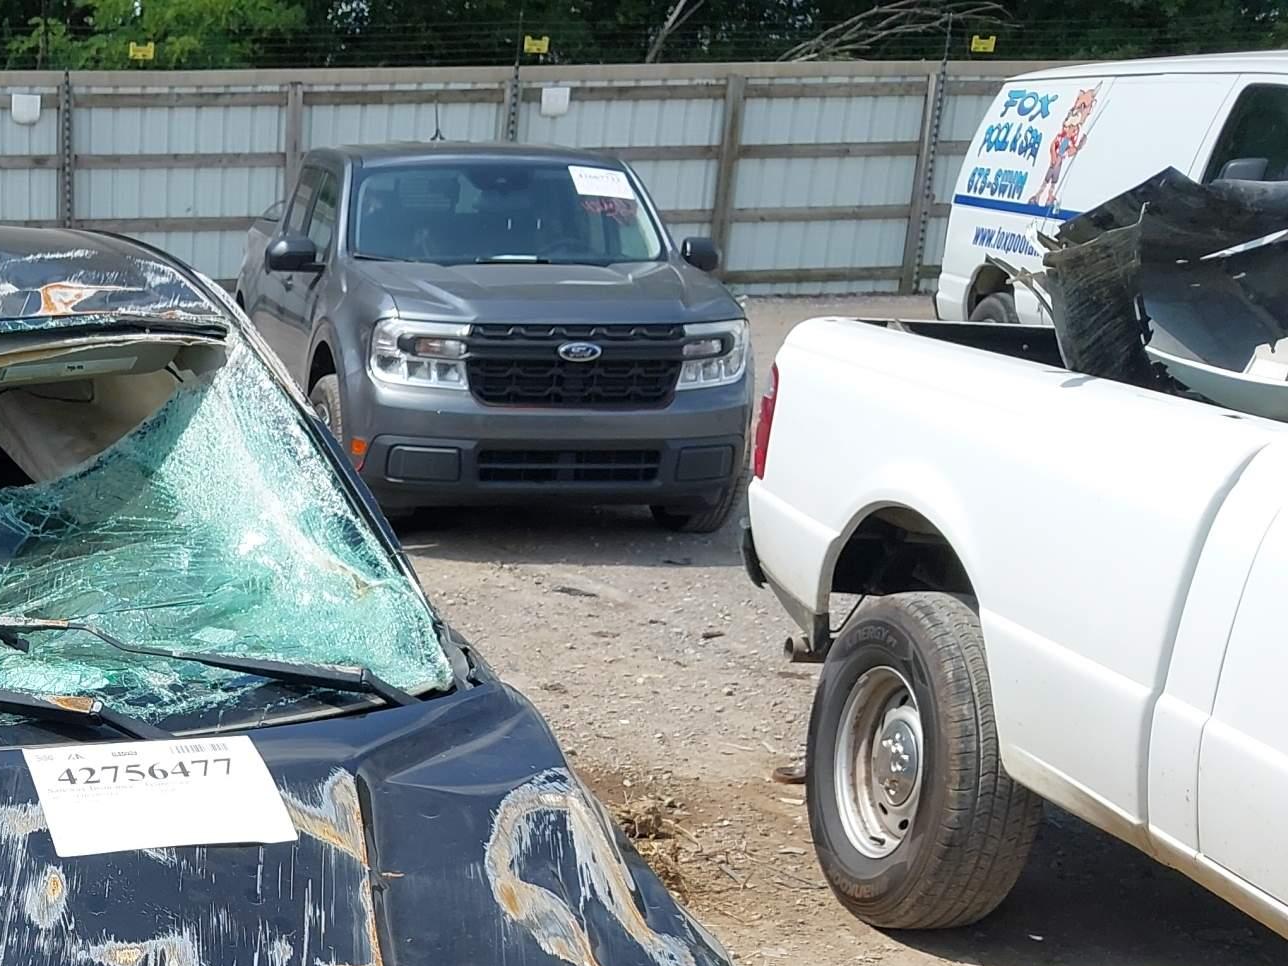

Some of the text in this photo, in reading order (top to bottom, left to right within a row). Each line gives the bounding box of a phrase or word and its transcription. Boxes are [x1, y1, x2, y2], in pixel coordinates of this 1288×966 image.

[1000, 88, 1059, 122] FOX
[978, 122, 1013, 157] POOL
[1017, 126, 1043, 167] SPA
[967, 166, 1029, 200] 675-SWIM
[57, 758, 231, 785] 42756477
